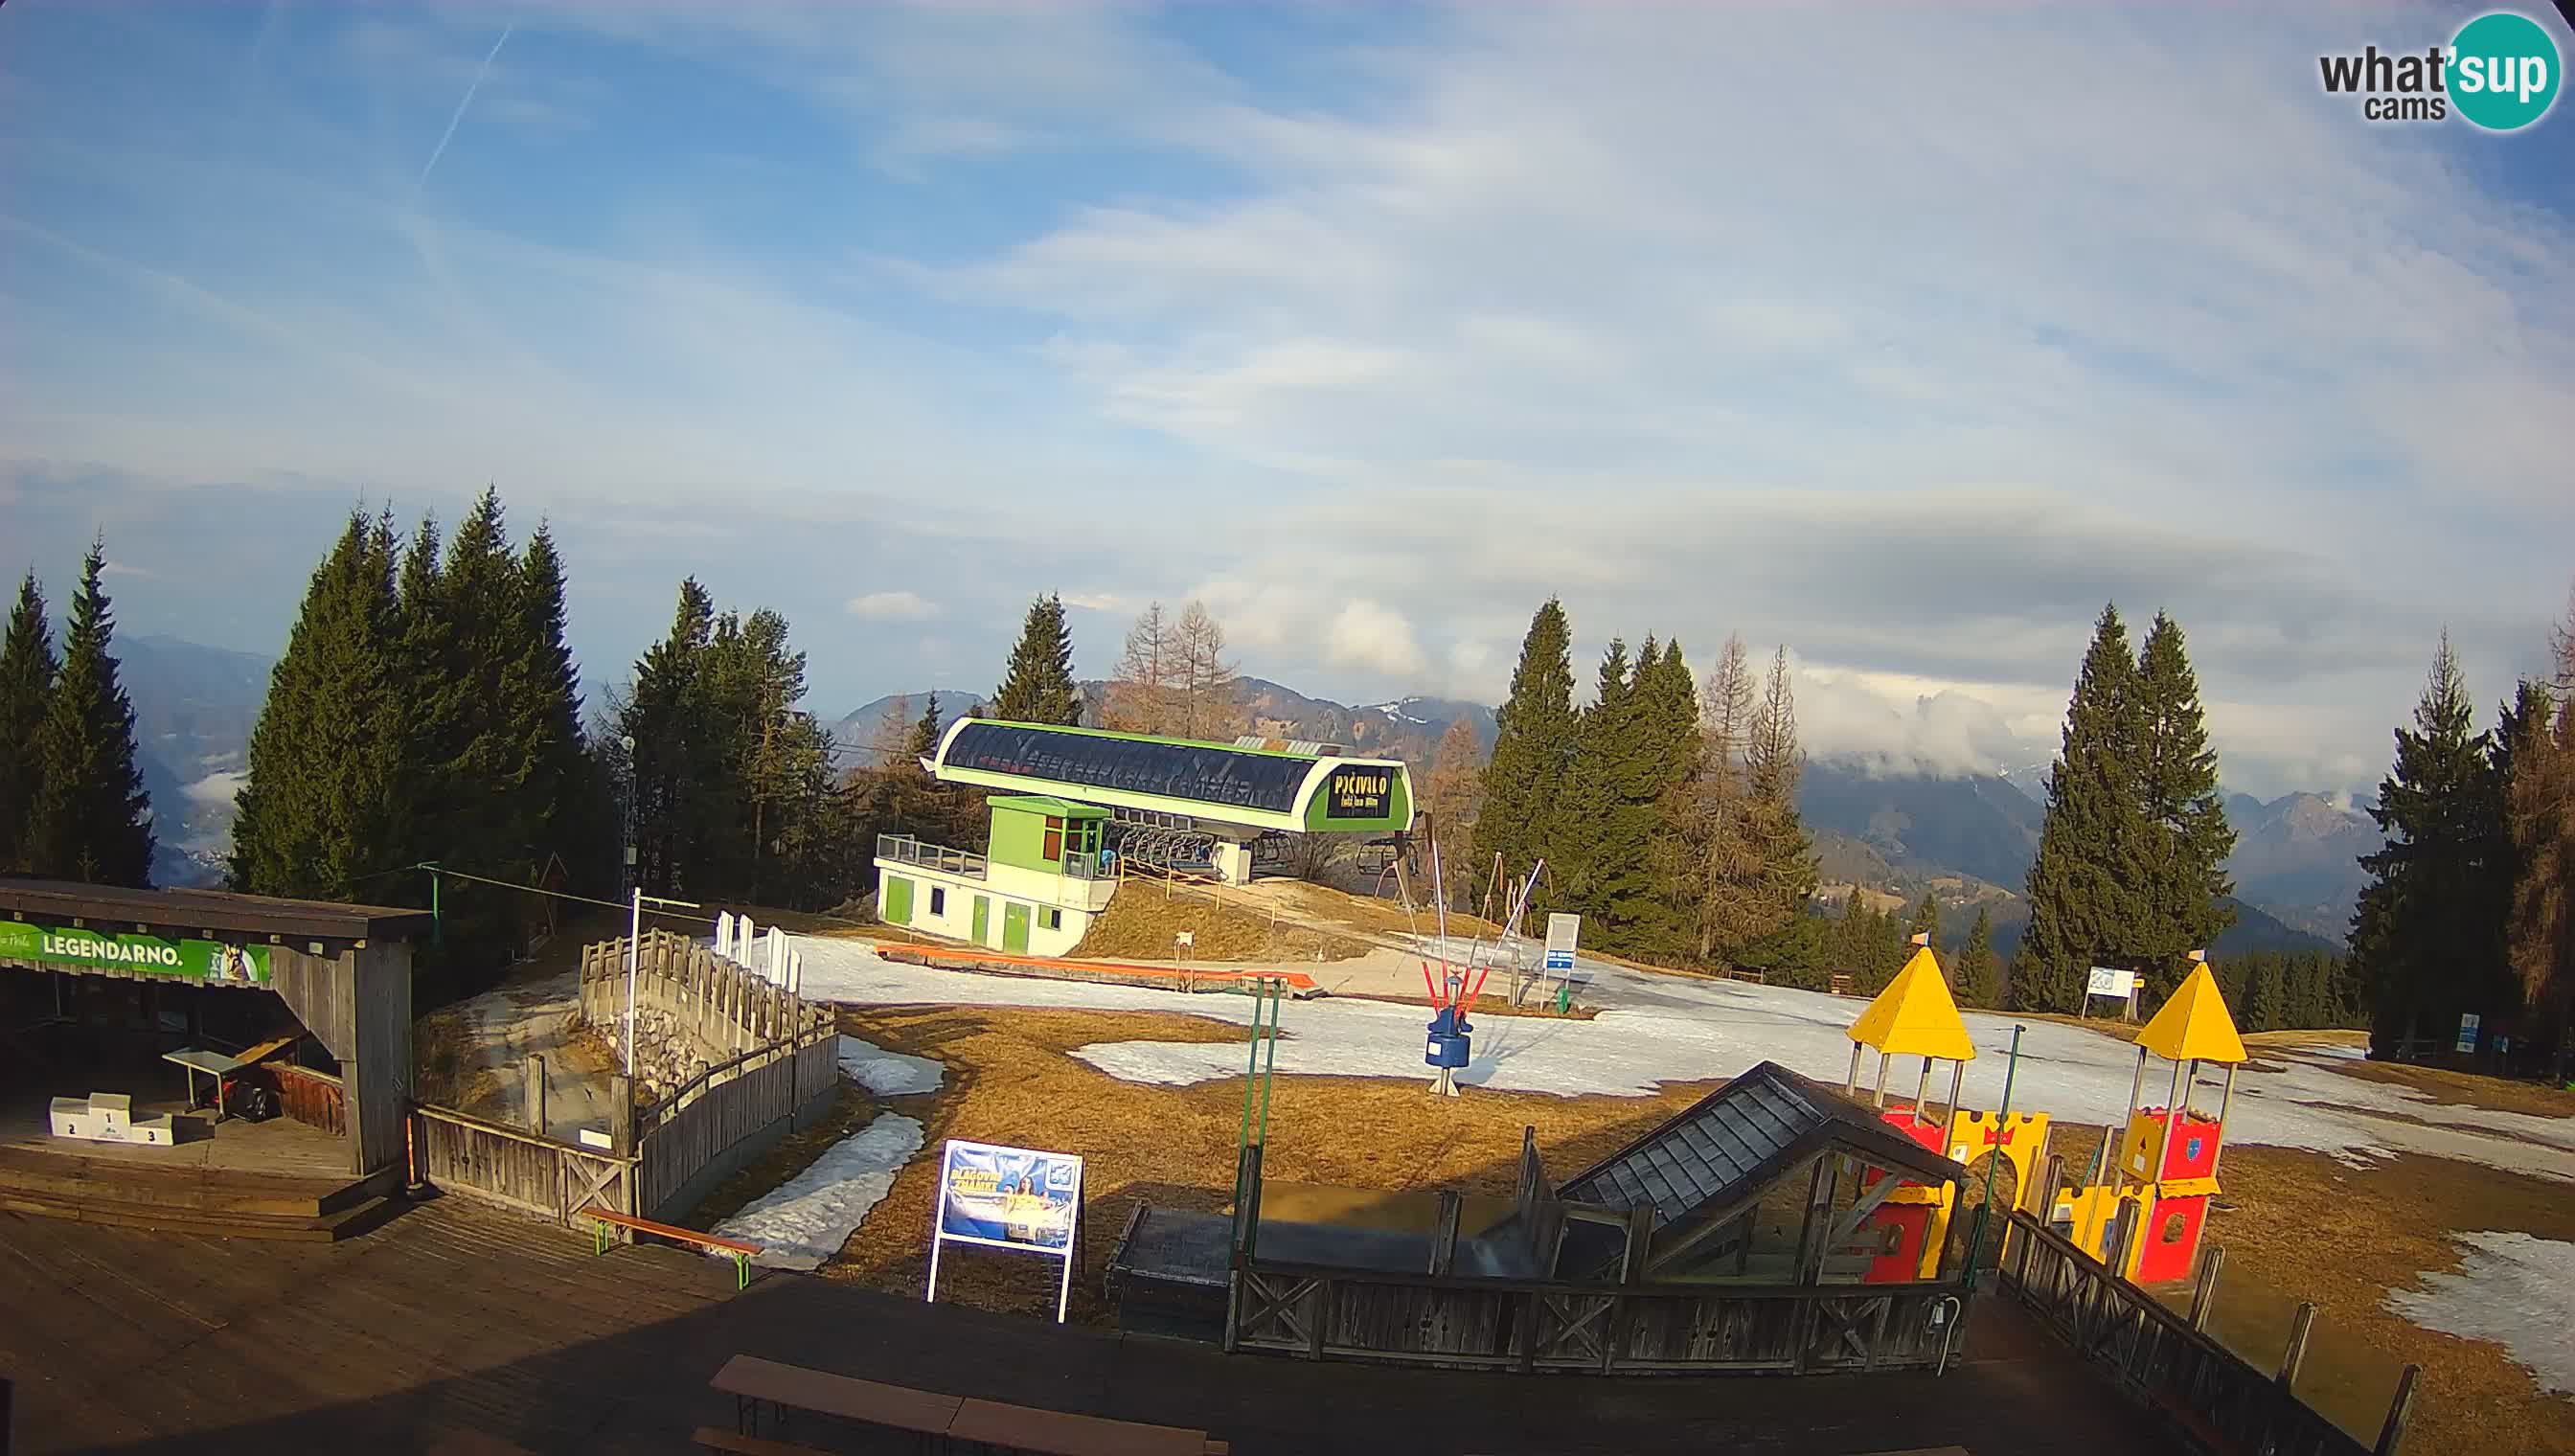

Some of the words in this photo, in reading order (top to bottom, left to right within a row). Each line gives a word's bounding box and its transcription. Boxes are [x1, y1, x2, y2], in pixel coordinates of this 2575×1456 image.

[44, 934, 184, 967] LEGENDARNO.
[105, 1112, 112, 1124] 1
[68, 1124, 76, 1135] 2
[148, 1130, 156, 1142] 3
